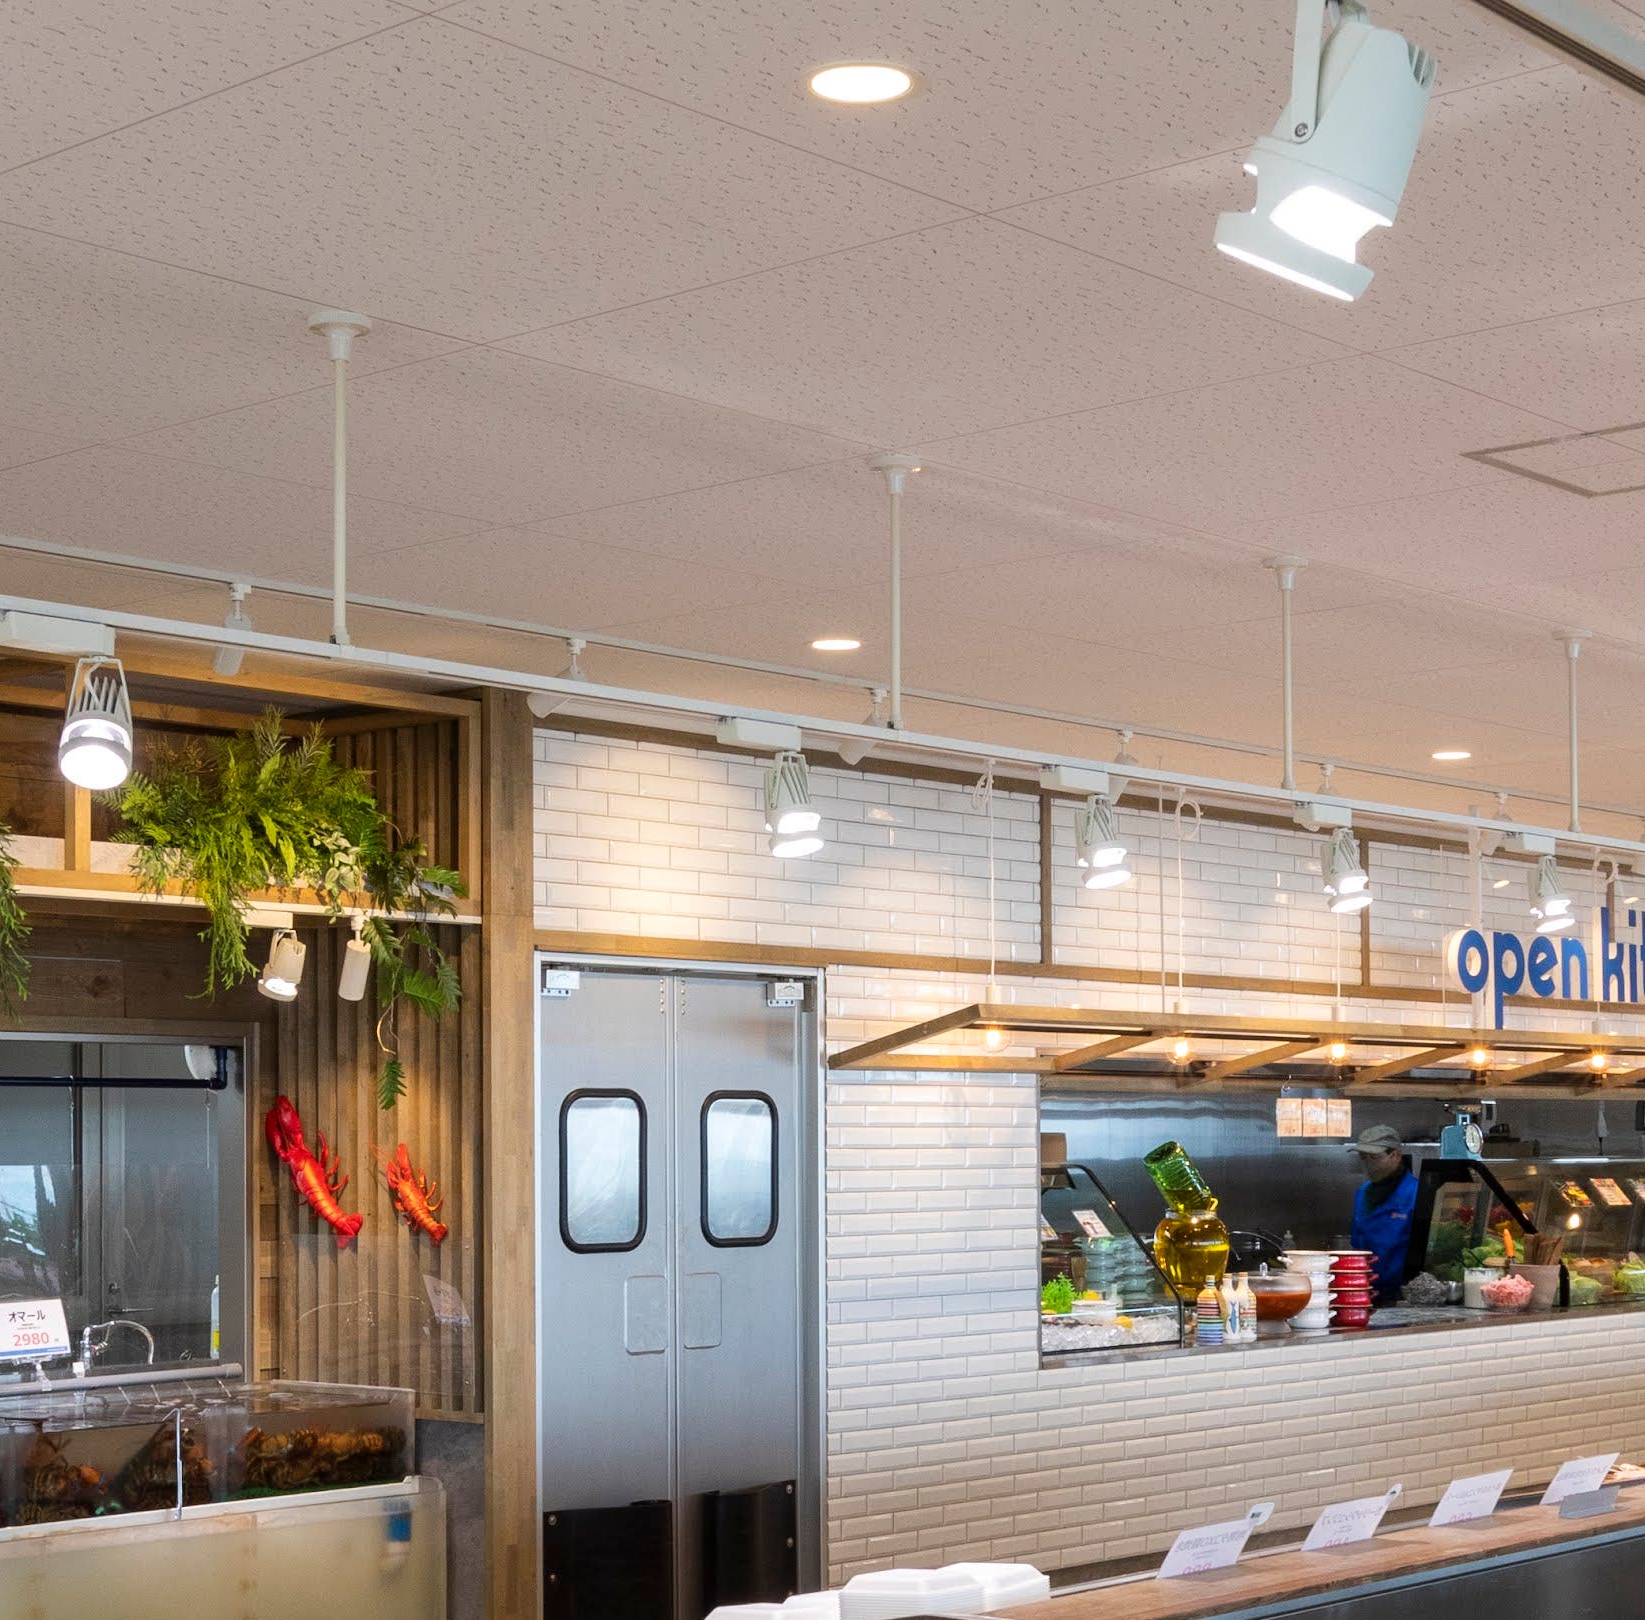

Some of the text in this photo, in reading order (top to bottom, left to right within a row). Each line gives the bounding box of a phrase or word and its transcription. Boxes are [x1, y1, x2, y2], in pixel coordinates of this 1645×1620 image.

[1457, 929, 1588, 1030] open
[8, 1309, 46, 1323] オマール
[12, 1332, 50, 1347] 2980
